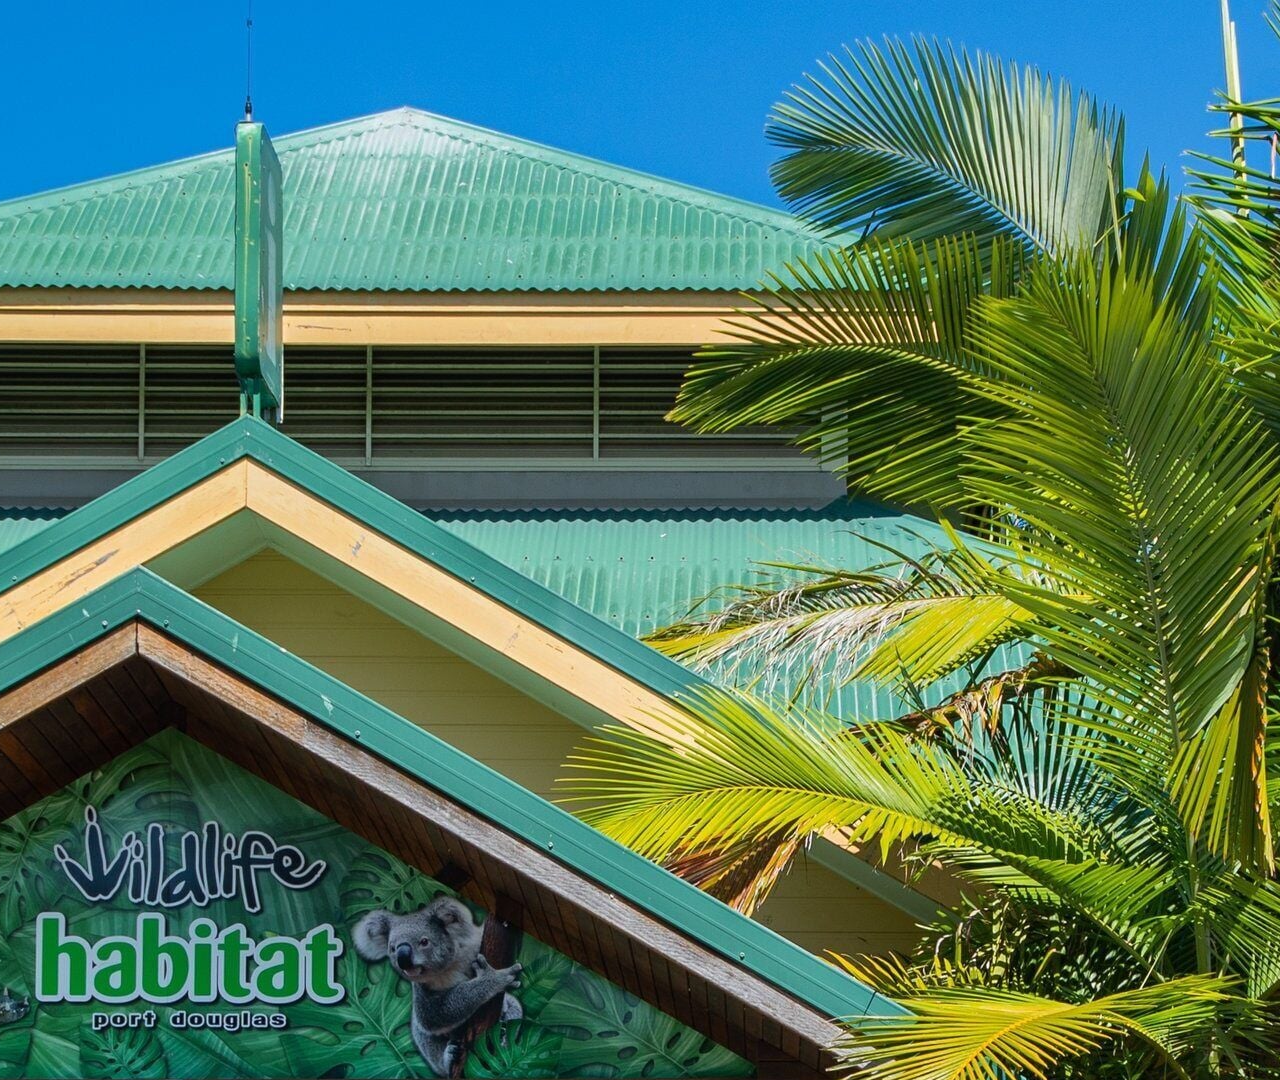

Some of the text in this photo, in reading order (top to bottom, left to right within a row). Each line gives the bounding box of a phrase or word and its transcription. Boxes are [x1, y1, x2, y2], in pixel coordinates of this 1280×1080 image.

[36, 912, 345, 1003] habitat
[93, 1011, 287, 1031] port douglas
